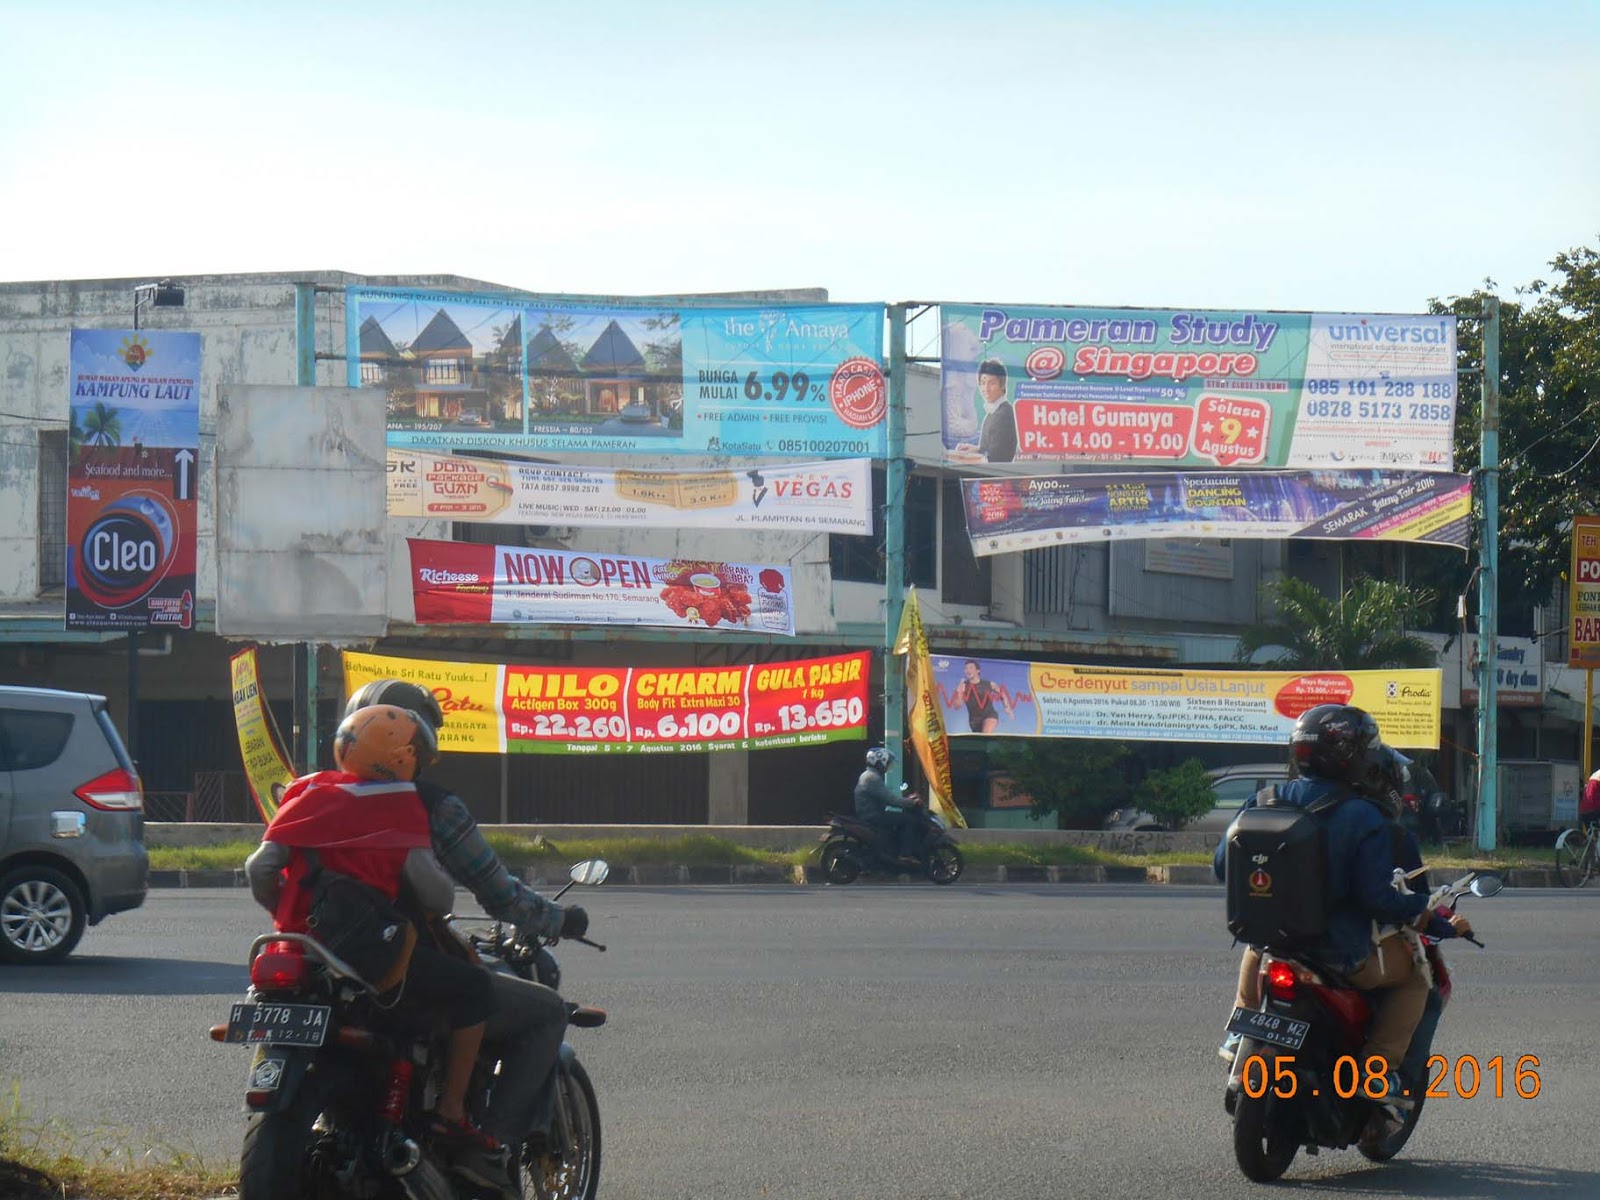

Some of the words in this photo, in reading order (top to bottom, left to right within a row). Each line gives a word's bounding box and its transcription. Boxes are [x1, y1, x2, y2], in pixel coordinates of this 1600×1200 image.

[725, 316, 755, 336] the
[785, 319, 849, 344] Amaya
[979, 309, 1156, 344] Pameran
[1170, 313, 1278, 352] Study
[1328, 319, 1447, 344] universal
[1073, 346, 1258, 381] Singapore
[75, 382, 150, 399] KAMPUNG
[155, 384, 194, 400] LAUT
[698, 370, 738, 384] BUNGA
[744, 370, 826, 402] 6.99%
[699, 386, 738, 399] MULAI
[835, 370, 850, 398] HARD
[843, 379, 878, 407] IPHONE
[1160, 388, 1173, 398] 50
[1308, 379, 1340, 395] 085
[1348, 380, 1377, 396] 101
[1422, 382, 1452, 399] 188
[1208, 400, 1261, 418] Selasa
[1307, 400, 1351, 417] 0878
[1359, 401, 1402, 419] 5173
[1409, 403, 1451, 421] 7858
[414, 423, 443, 431] 195/207
[704, 413, 725, 422] FREE
[726, 413, 760, 422] ADMIN
[769, 414, 791, 423] FREE
[792, 415, 828, 424] PROVISI
[1033, 405, 1085, 426] Hotel
[1091, 406, 1174, 433] Gumaya
[1025, 430, 1054, 449] Pk.
[1061, 431, 1112, 449] 14.00
[1132, 432, 1184, 450] 19.00
[1220, 418, 1242, 445] 9
[411, 436, 464, 445] DAPATKAN
[466, 437, 506, 446] DISKON
[508, 438, 549, 447] KHUSUS
[551, 439, 588, 448] SELAMA
[591, 440, 636, 449] PAMERAN
[722, 441, 761, 451] KotaSatu
[778, 439, 870, 454] 085100207001
[1201, 440, 1255, 456] Agustus
[85, 463, 121, 478] Seafood
[122, 464, 139, 476] and
[433, 461, 477, 473] DONG
[433, 482, 478, 494] GUAN
[521, 483, 540, 491] TATA
[774, 480, 853, 499] VEGAS
[1183, 477, 1241, 486] Spectacular
[1109, 497, 1149, 506] ARTIS
[1188, 488, 1242, 497] DANCING
[1186, 498, 1247, 507] FOUNTAIN
[1322, 507, 1369, 534] SEMARAK
[1371, 495, 1399, 513] Jateng
[1397, 485, 1415, 499] Fair
[1415, 476, 1436, 493] 2016
[751, 515, 803, 523] PLAMPITAN
[818, 517, 866, 527] SEMARANG
[1582, 535, 1596, 547] TEH
[94, 531, 156, 571] Cleo
[420, 568, 479, 585] Richeese
[503, 552, 564, 587] NOW
[1580, 560, 1600, 579] PO
[516, 590, 552, 599] Jenderal
[553, 591, 591, 600] Sudirman
[622, 594, 660, 604] Semarang
[345, 660, 383, 675] Belanja
[386, 666, 398, 676] ke
[401, 668, 415, 678] Sri
[418, 670, 441, 680] Ratu
[756, 668, 806, 691] GULA
[809, 659, 862, 687] PASIR
[506, 673, 620, 698] MILO
[636, 670, 742, 697] CHARM
[1130, 677, 1182, 693] sampai
[1185, 677, 1218, 691] Usia
[1220, 677, 1265, 696] Lanjut
[1401, 685, 1431, 698] Prodia
[637, 698, 660, 711] Body
[662, 697, 676, 709] Fit
[680, 697, 704, 708] Extra
[706, 696, 726, 708] Maxi
[727, 696, 740, 707] 30
[802, 689, 808, 699] 1
[811, 689, 825, 701] kg
[1068, 698, 1093, 706] Agustus
[1186, 697, 1217, 706] Sixteen
[1224, 698, 1266, 707] Restaurant
[511, 699, 555, 712] Actigen
[557, 700, 579, 711] Box
[584, 699, 617, 712] 300g
[754, 721, 775, 734] Rp.
[778, 696, 863, 731] 13.650
[511, 722, 533, 735] Rp.
[533, 714, 625, 738] 22.260
[635, 726, 655, 738] Rp.
[657, 711, 741, 737] 6.100
[1260, 724, 1279, 732] Med
[566, 743, 598, 752] Tanggal
[640, 744, 674, 753] Agustus
[680, 743, 702, 751] 2016
[708, 742, 736, 752] Syarat
[755, 736, 796, 747] ketentuan
[799, 733, 827, 742] berlaku
[232, 1007, 243, 1023] H
[253, 1004, 291, 1025] 5778
[303, 1009, 323, 1026] JA
[1233, 1008, 1243, 1021] H
[1249, 1013, 1281, 1030] 4848
[1286, 1022, 1307, 1037] MZ
